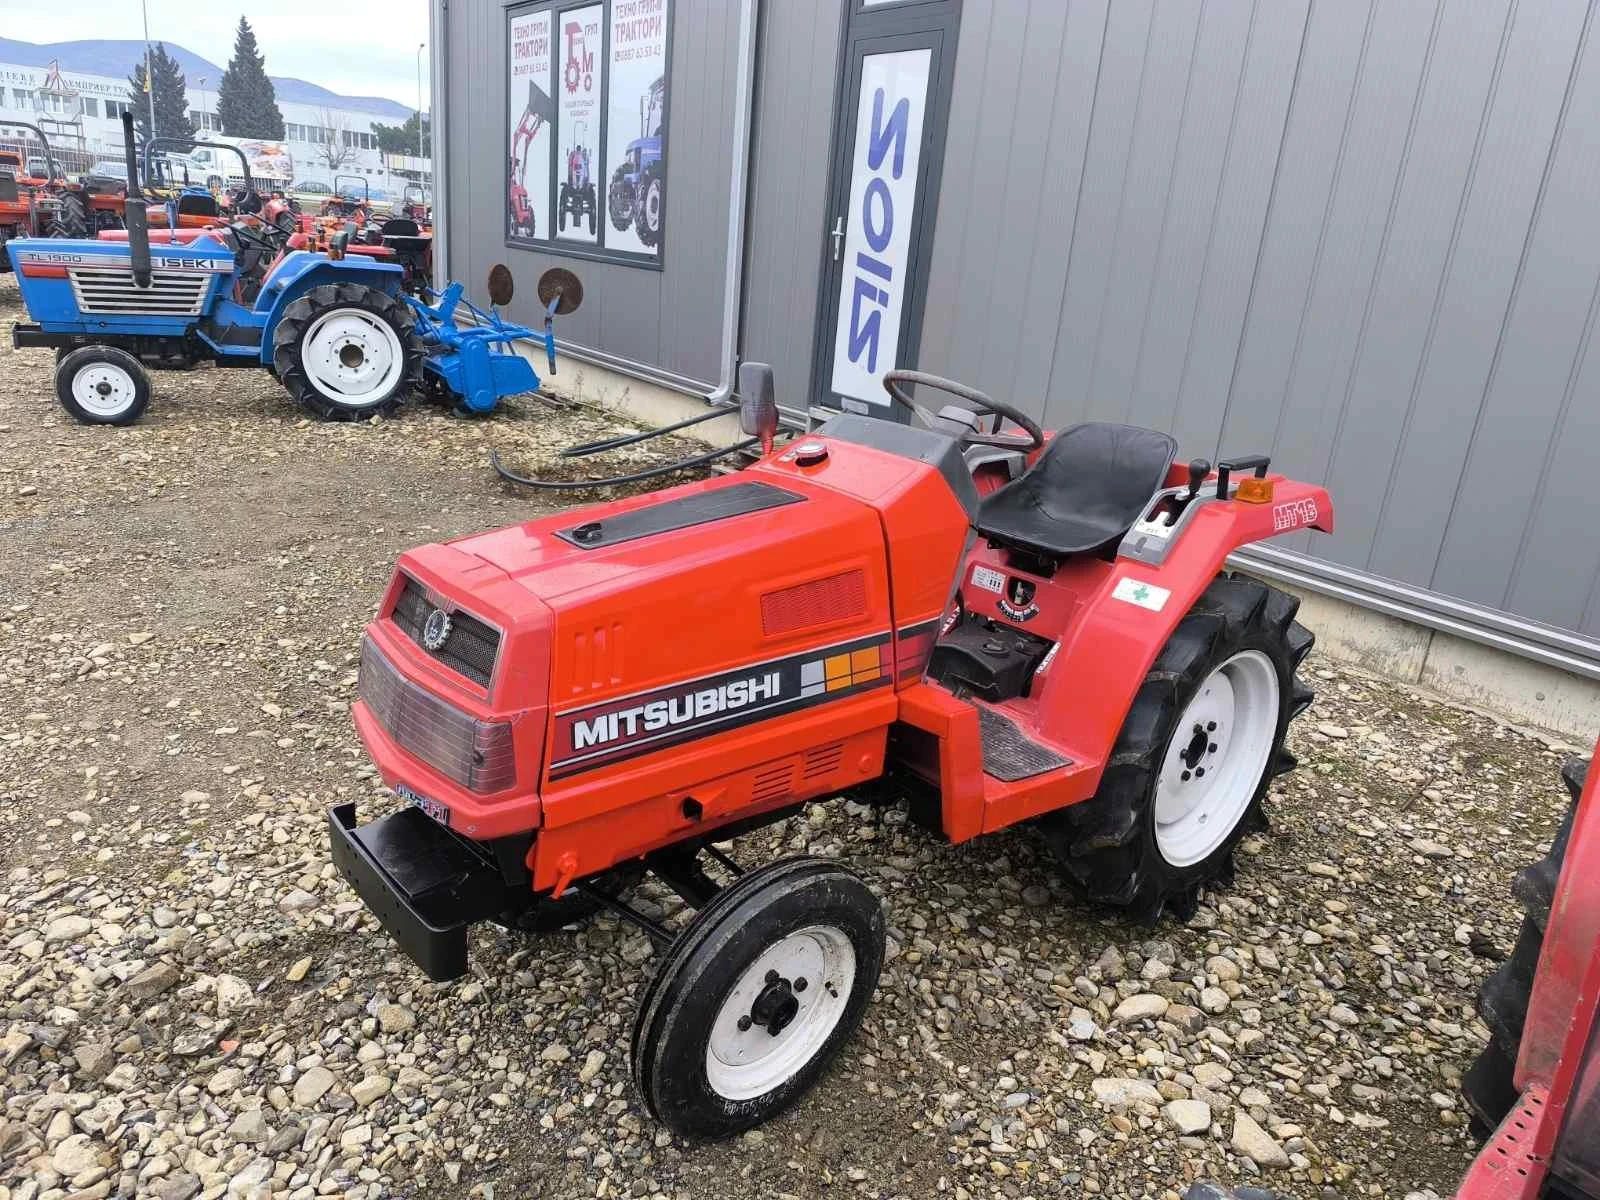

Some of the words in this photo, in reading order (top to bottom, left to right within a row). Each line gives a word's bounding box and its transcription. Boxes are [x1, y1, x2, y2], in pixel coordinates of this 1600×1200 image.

[615, 16, 662, 43] ТРАКТОРИ
[514, 37, 548, 58] ТРАКТОРИ
[28, 252, 83, 263] TL1900
[161, 257, 214, 269] ISEKI
[573, 671, 780, 750] MITSUBISHI
